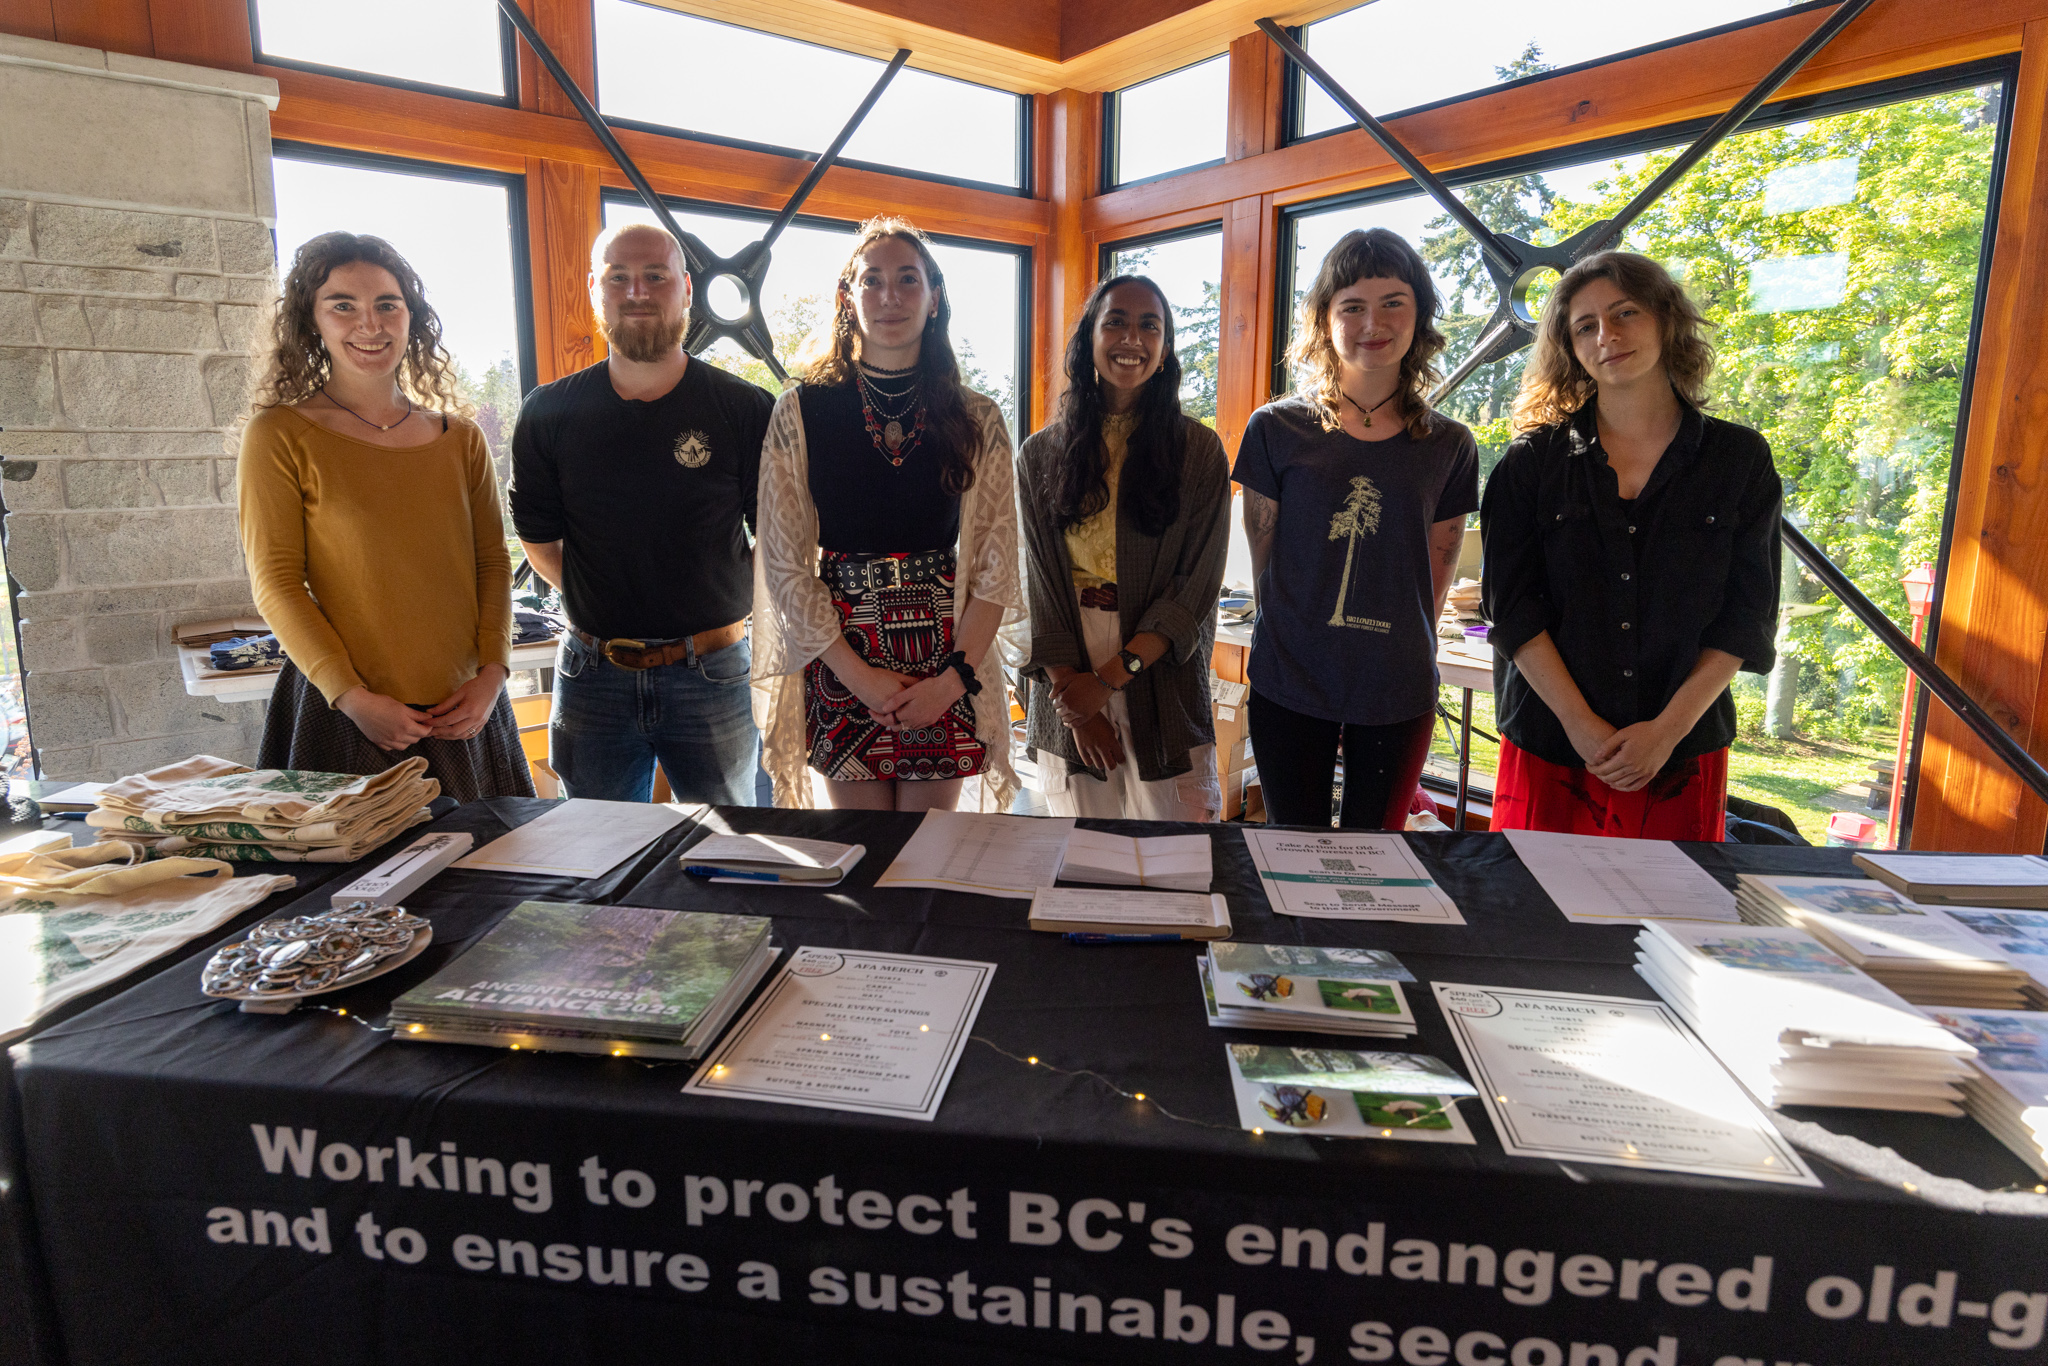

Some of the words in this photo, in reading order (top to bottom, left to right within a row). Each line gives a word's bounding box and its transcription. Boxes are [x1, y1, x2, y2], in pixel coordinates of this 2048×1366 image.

[1346, 615, 1356, 623] BIG
[1356, 617, 1376, 626] LONELY
[1376, 620, 1392, 629] DOUG
[880, 965, 924, 974] MERCH
[470, 980, 566, 996] ANCIENT
[566, 987, 648, 1001] FOREST
[434, 987, 608, 1012] ALLIANCE
[612, 1001, 682, 1016] 2025
[802, 1000, 844, 1009] SPECIAL
[847, 1004, 882, 1012] EVENT
[884, 1008, 930, 1016] SAVINGS
[1514, 1002, 1541, 1010] AFA
[1544, 1004, 1597, 1014] MERCH
[1460, 1006, 1488, 1014] FREE
[796, 1021, 836, 1029] MAGNETS
[1508, 1044, 1557, 1054] SPECIAL
[1562, 1049, 1602, 1057] EVENT
[784, 1062, 837, 1071] PROTECTOR
[840, 1068, 882, 1076] PREMIUM
[1531, 1069, 1580, 1078] MAGNETS
[766, 1077, 803, 1085] BUTTON
[816, 1083, 870, 1092] BOOKMARK
[1582, 1084, 1633, 1093] STICKERS
[1568, 1099, 1608, 1108] SPRING
[1576, 1116, 1642, 1127] PROTECTOR
[1646, 1123, 1698, 1133] PREMIUM
[1580, 1135, 1625, 1144] BUTTON
[1642, 1141, 1710, 1153] BOOKMARK
[251, 1124, 552, 1214] Working
[580, 1157, 655, 1207] to
[685, 1176, 976, 1239] protect
[1010, 1192, 1193, 1259] BC's
[1226, 1223, 1773, 1312] endangered
[1806, 1266, 2048, 1350] old-g
[207, 1207, 331, 1254] and
[356, 1213, 427, 1263] to
[453, 1235, 709, 1294] ensure
[738, 1262, 779, 1301] a
[810, 1268, 1314, 1364] sustainable,
